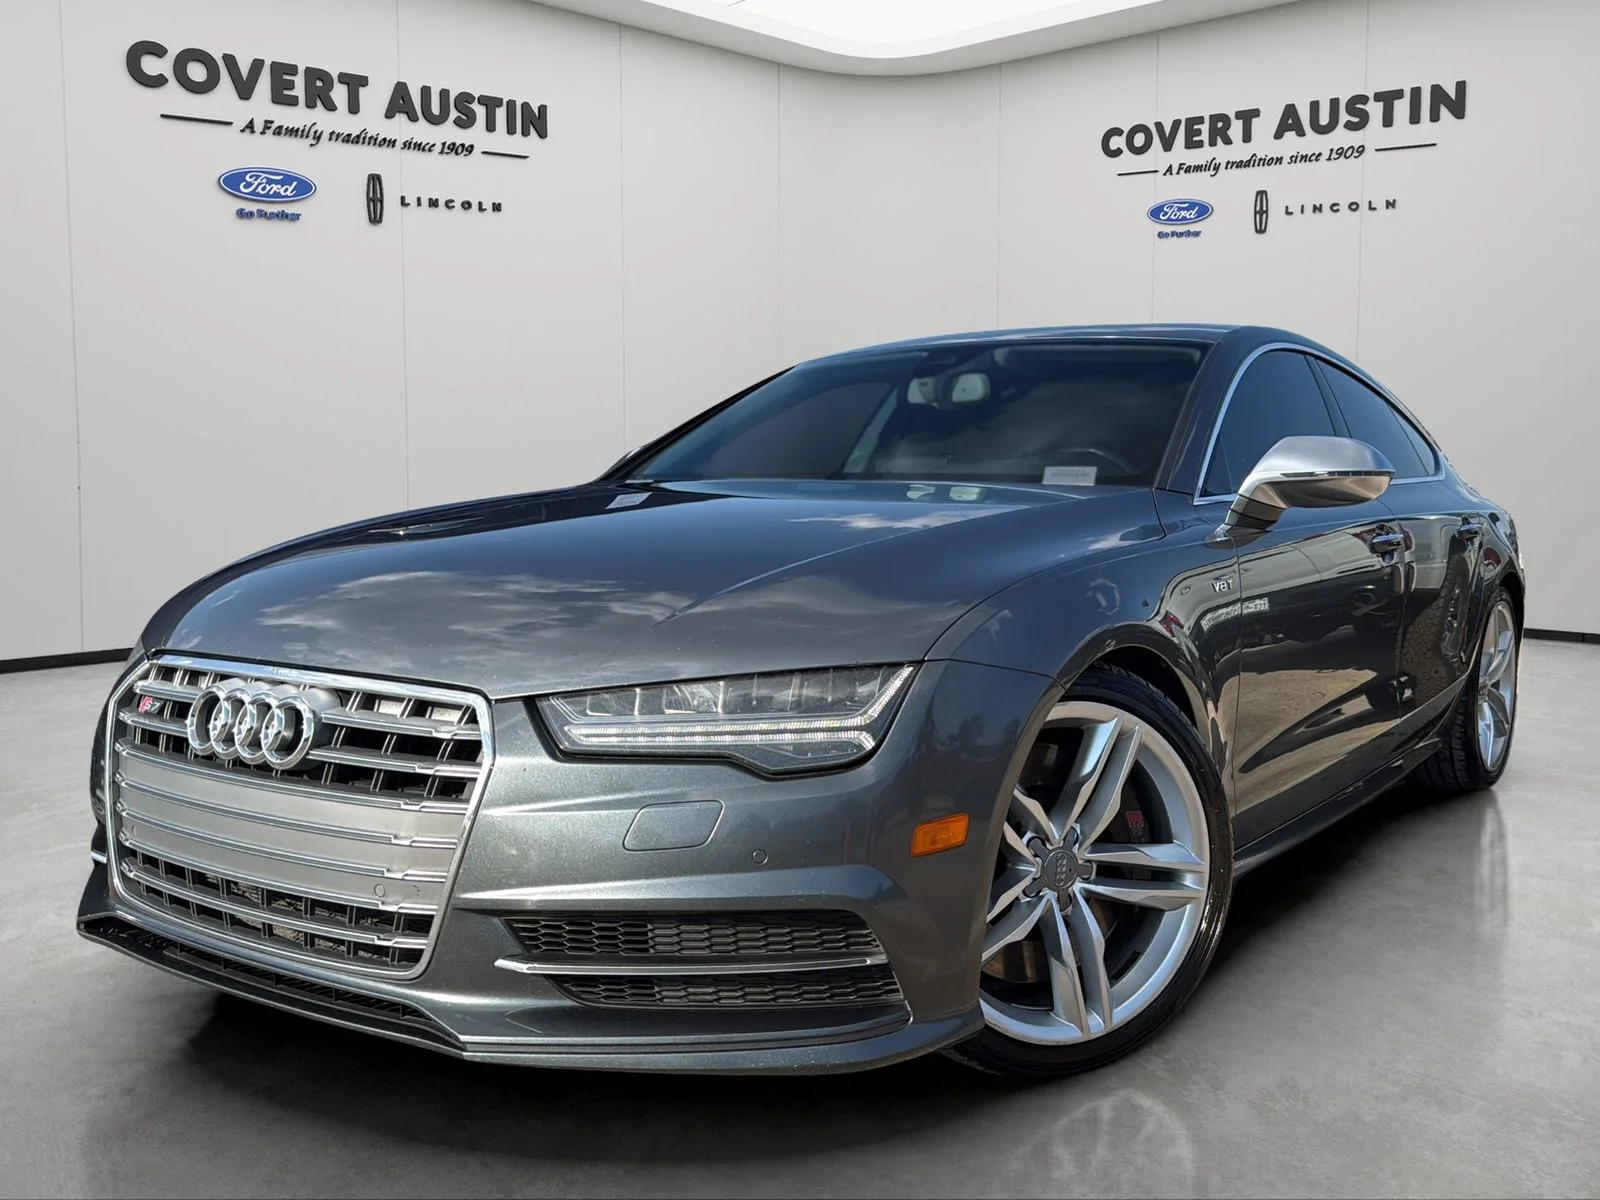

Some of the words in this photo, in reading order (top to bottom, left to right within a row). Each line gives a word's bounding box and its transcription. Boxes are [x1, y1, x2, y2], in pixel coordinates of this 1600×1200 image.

[126, 40, 369, 115] COVERT
[384, 81, 549, 140] AUSTIN
[1100, 108, 1261, 159] COVERT
[1273, 79, 1467, 141] AUSTIN
[240, 117, 256, 135] A
[259, 119, 324, 147] Family
[328, 128, 397, 149] tradition
[400, 136, 437, 154] since
[438, 140, 476, 157] 1909
[1162, 163, 1174, 177] A
[1175, 157, 1222, 178] Family
[1224, 153, 1284, 171] tradition
[1287, 150, 1323, 165] since
[1325, 144, 1366, 162] 1909
[239, 171, 298, 197] Ford
[235, 207, 255, 220] Go
[399, 194, 503, 213] LINCOLN
[1159, 202, 1200, 220] Ford
[1284, 198, 1398, 216] LINCOLN
[1157, 230, 1170, 239] Go
